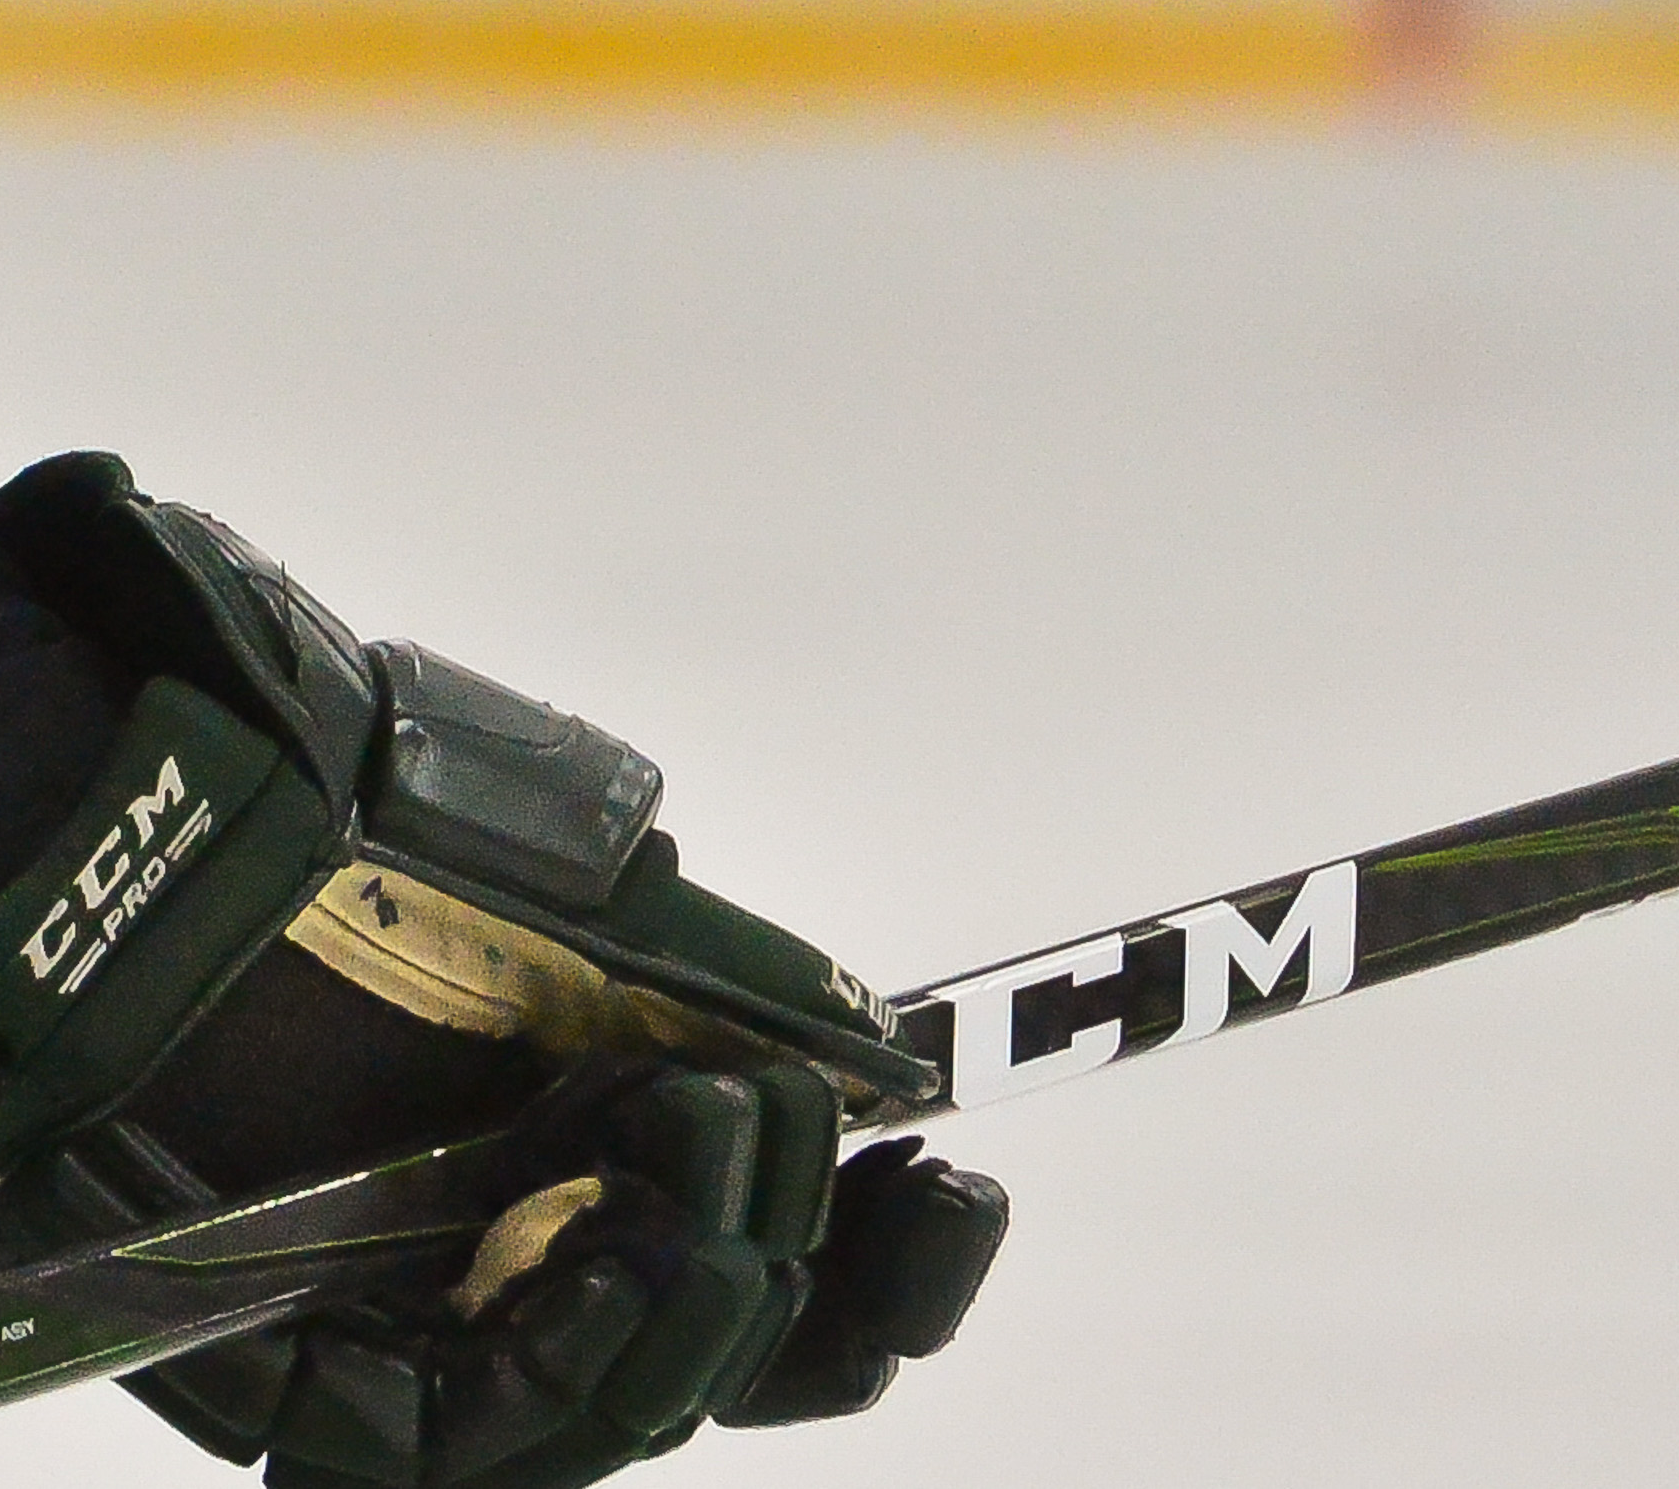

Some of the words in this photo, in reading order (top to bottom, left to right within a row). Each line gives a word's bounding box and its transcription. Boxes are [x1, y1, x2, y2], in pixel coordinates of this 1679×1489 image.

[19, 755, 185, 979] CCM
[102, 856, 166, 942] PRO
[928, 859, 1357, 1110] CM
